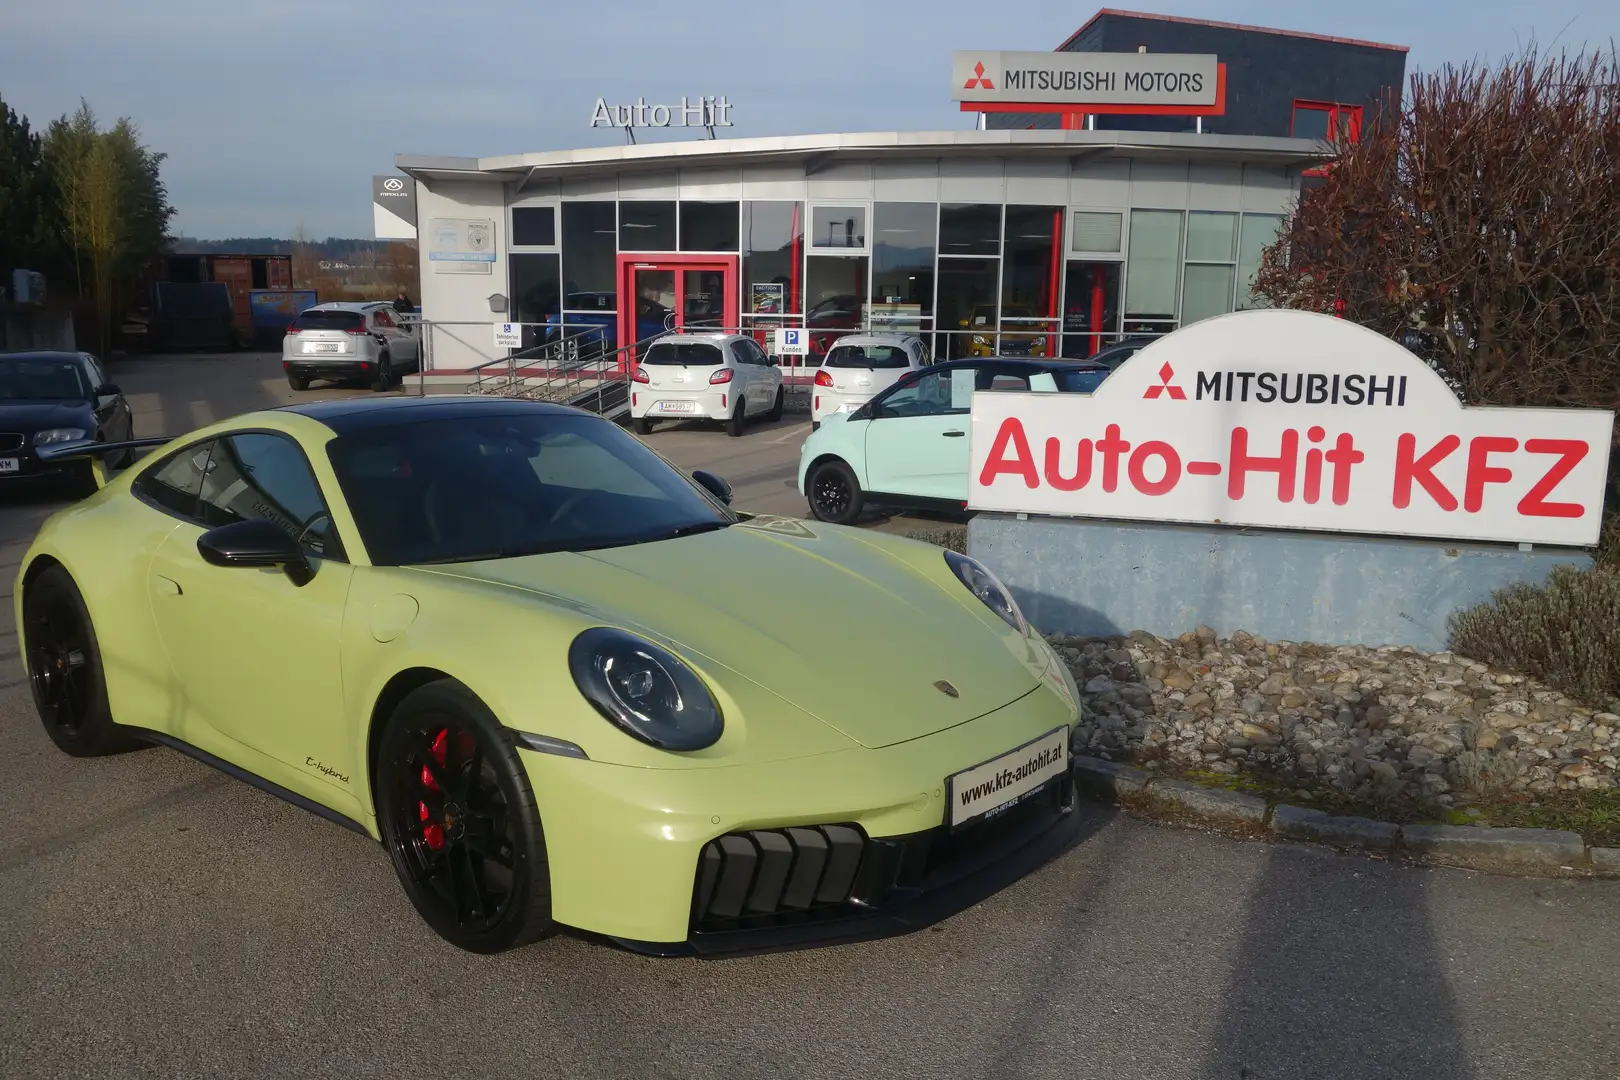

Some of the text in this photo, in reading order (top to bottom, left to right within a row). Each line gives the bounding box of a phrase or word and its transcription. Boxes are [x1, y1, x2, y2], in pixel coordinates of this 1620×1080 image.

[1004, 70, 1203, 92] MITSUBISHI MOTORS
[589, 95, 734, 127] Auto Hit
[781, 345, 802, 353] Kunden
[1195, 371, 1407, 407] MITSUBISHI
[979, 417, 1590, 518] Auto-Hit KFZ
[960, 741, 1063, 806] www.kfz-autohit.at
